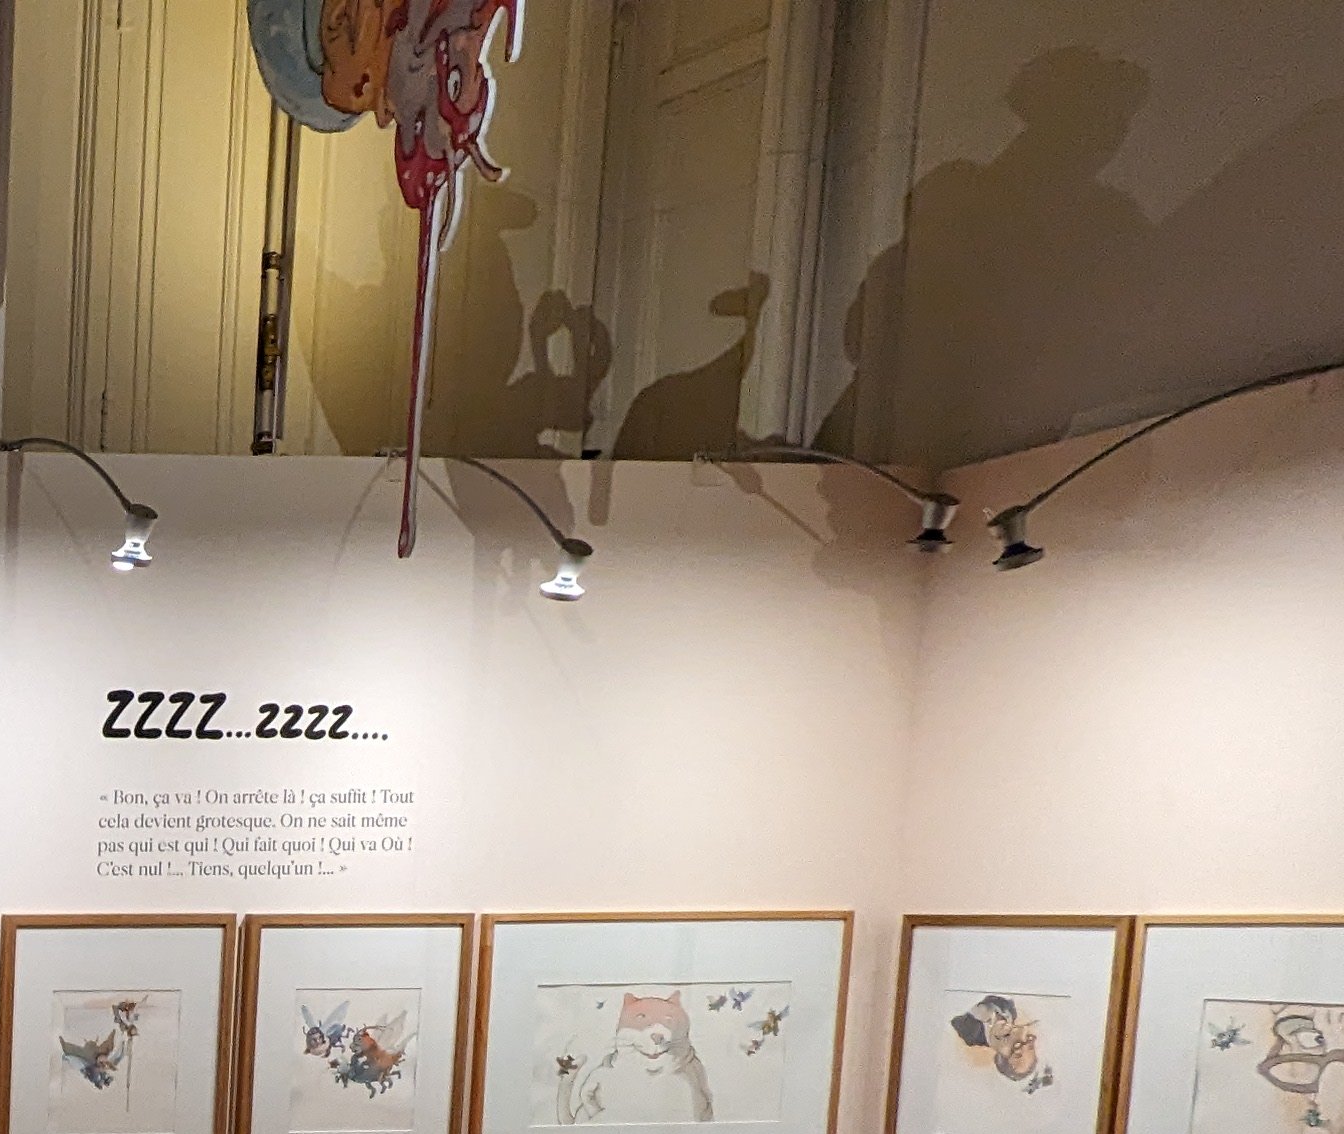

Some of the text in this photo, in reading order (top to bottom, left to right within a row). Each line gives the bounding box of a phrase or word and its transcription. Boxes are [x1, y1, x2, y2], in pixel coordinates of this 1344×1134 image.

[113, 789, 148, 805] Bon,
[153, 793, 170, 808] ça
[175, 793, 192, 805] va
[205, 789, 228, 805] On
[233, 789, 278, 804] arrête
[283, 789, 296, 804] là
[309, 792, 326, 808] ça
[330, 789, 367, 804] suffit
[380, 789, 415, 804] Tout
[98, 813, 408, 832] cela devient grotesque. On ne sait même
[97, 841, 124, 856] pas
[128, 837, 153, 856] qui
[157, 840, 179, 852] est
[184, 837, 209, 856] qui
[222, 837, 250, 856] Qui
[254, 836, 277, 852] fait
[281, 837, 316, 855] quoi
[328, 836, 356, 855] Qui
[360, 840, 377, 851] va
[381, 836, 403, 851] Où
[138, 861, 162, 876] nul
[188, 860, 233, 877] Tiens,
